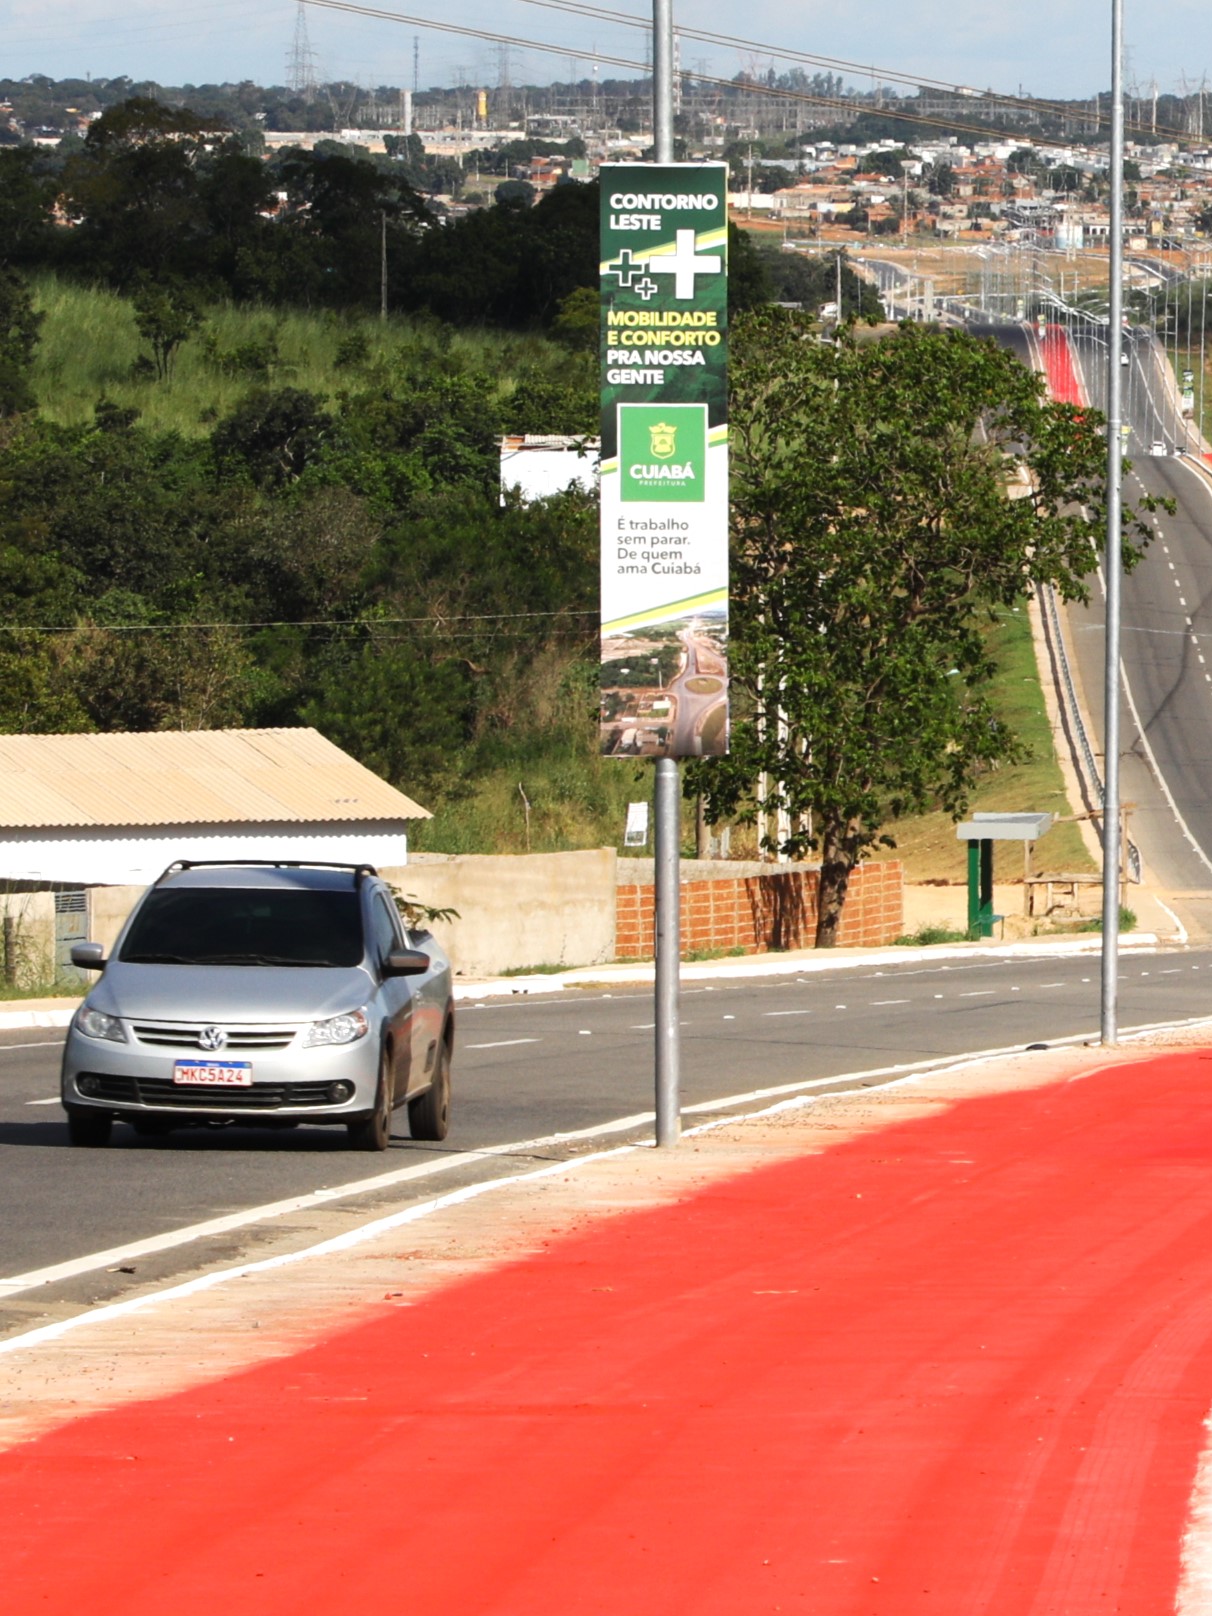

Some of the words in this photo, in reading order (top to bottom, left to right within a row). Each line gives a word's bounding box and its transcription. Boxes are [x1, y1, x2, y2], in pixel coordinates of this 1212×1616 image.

[609, 193, 718, 210] CONTORNO
[610, 214, 661, 230] LESTE
[607, 311, 717, 326] MOBILIDADE
[607, 331, 618, 345] E
[621, 330, 721, 346] CONFORTO
[607, 350, 642, 365] PRA
[644, 350, 706, 365] NOSSA
[606, 369, 664, 384] GENTE
[629, 461, 695, 479] CUIABÁ
[617, 515, 625, 530] É
[629, 518, 689, 530] trabalho
[617, 535, 646, 545] sem
[650, 536, 691, 548] parar.
[617, 547, 637, 560] De
[641, 550, 683, 563] quem
[617, 565, 647, 574] ama
[651, 562, 701, 574] Cuiabá
